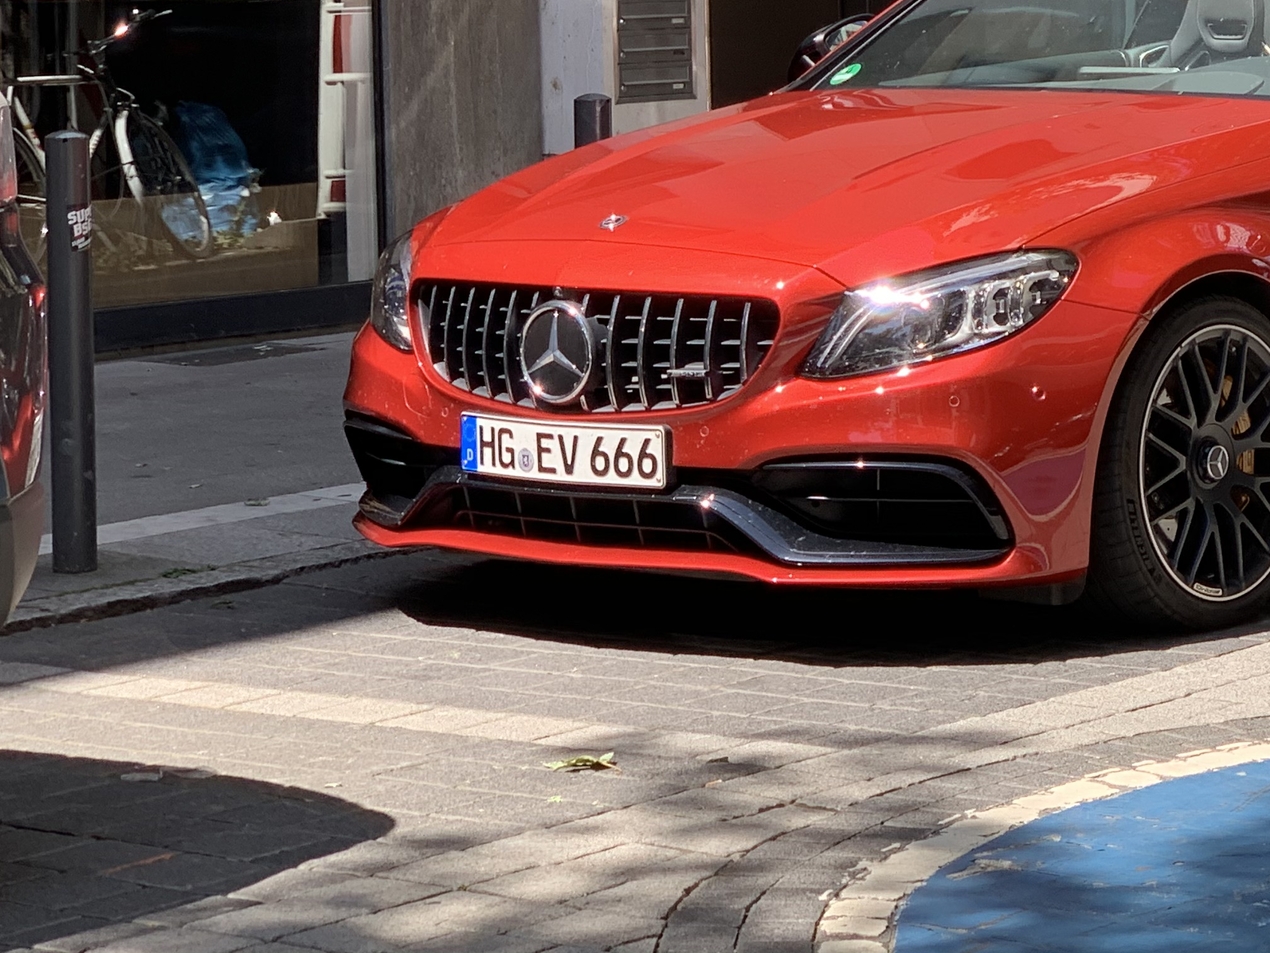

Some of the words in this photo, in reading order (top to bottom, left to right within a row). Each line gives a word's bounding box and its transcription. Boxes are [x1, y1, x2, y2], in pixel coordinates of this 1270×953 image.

[478, 424, 516, 471] HG
[536, 431, 579, 476] EV
[590, 435, 658, 480] 666
